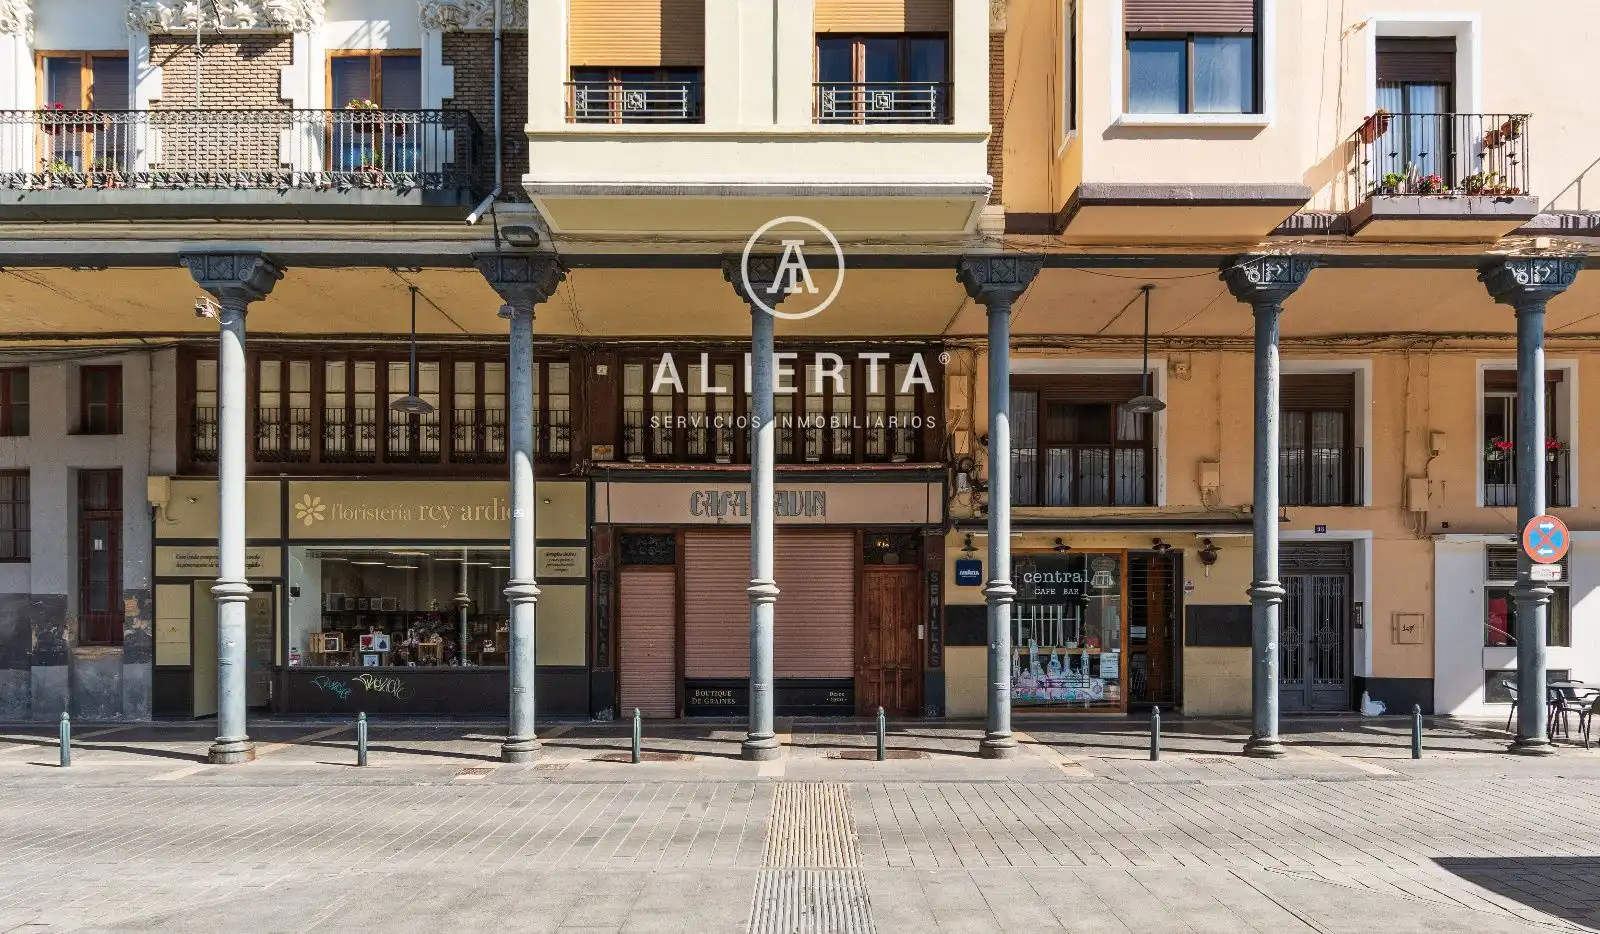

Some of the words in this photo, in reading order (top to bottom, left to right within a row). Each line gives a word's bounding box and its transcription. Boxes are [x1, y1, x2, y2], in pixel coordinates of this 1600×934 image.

[331, 503, 412, 521] floristería
[419, 502, 453, 528] rey
[690, 491, 748, 516] CASA
[774, 491, 826, 516] AVIN
[1023, 569, 1090, 583] central
[930, 571, 939, 666] SEMILLAS
